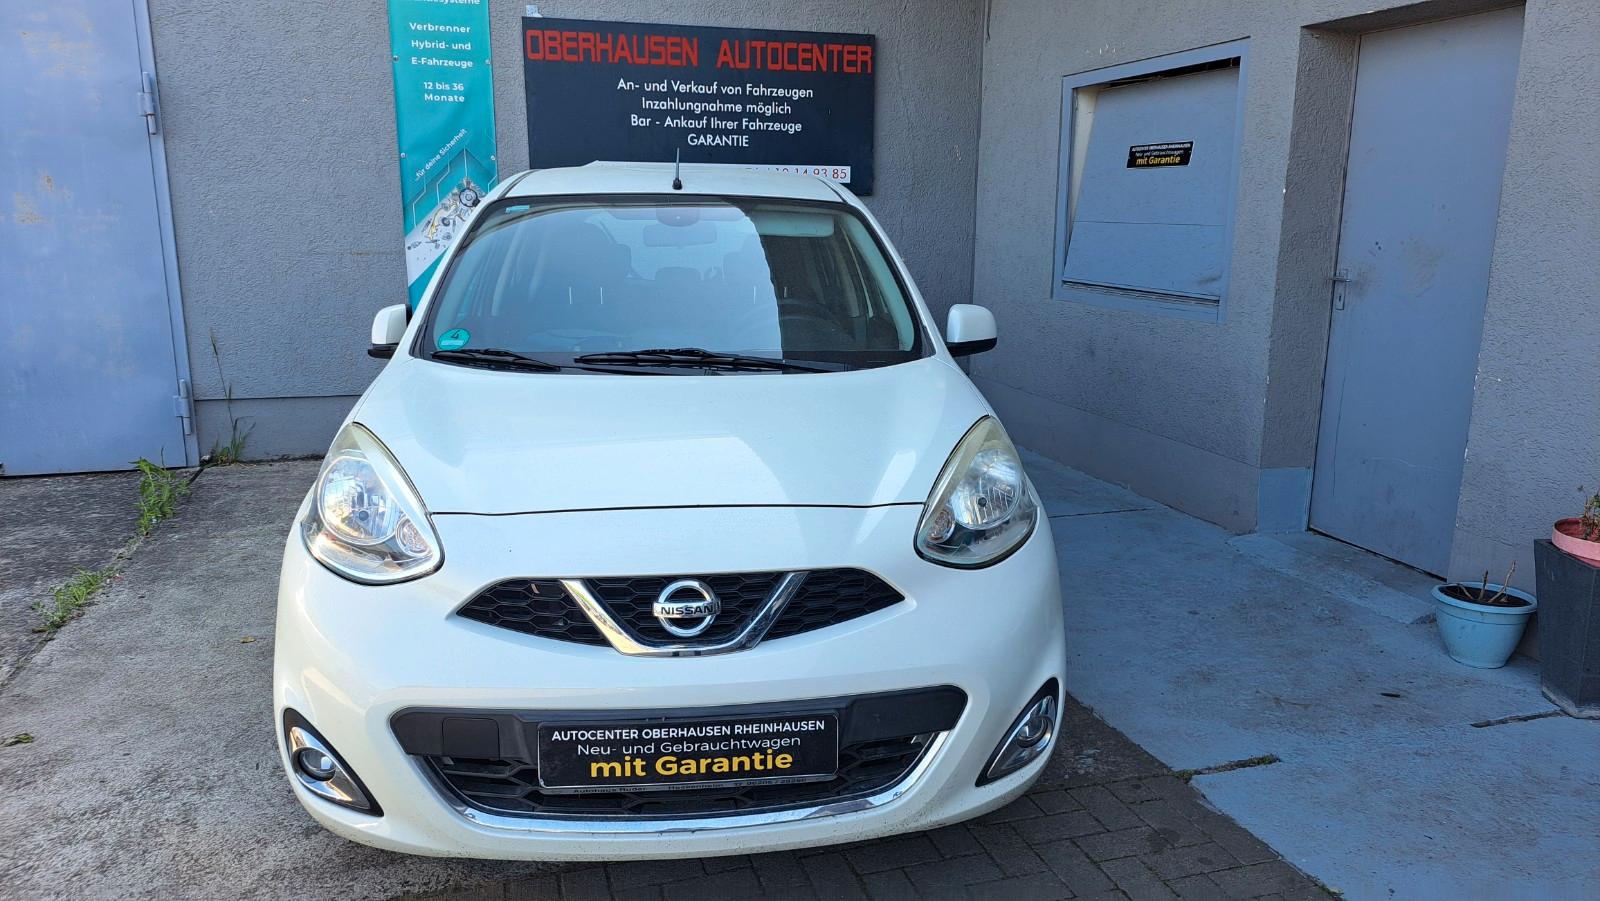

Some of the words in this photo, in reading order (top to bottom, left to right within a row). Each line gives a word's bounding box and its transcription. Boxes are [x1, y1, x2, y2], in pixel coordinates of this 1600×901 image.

[409, 22, 471, 33] Verbrenner
[411, 40, 449, 50] Hybrid-
[452, 42, 472, 51] und
[525, 29, 699, 68] OBERHAUSEN
[716, 39, 873, 74] AUTOCENTER
[411, 57, 473, 69] E-Fahrzeuge
[424, 82, 434, 90] 12
[436, 82, 450, 91] bis
[453, 83, 464, 91] 36
[617, 78, 640, 91] An-
[644, 80, 668, 92] und
[671, 80, 718, 94] Verkauf
[721, 85, 742, 95] von
[746, 83, 814, 100] Fahrzeugen
[424, 93, 465, 102] Monate
[642, 97, 743, 114] Inzahlungnahme
[746, 102, 792, 117] möglich
[631, 114, 651, 127] Bar
[664, 115, 707, 129] Ankauf
[711, 117, 738, 130] Ihrer
[742, 118, 802, 134] Fahrzeuge
[687, 133, 749, 147] GARANTIE
[425, 154, 441, 171] deine
[439, 128, 468, 156] Sicherheit
[1136, 157, 1148, 165] mit
[1148, 155, 1180, 165] Garantie
[832, 168, 847, 179] 85
[660, 605, 714, 615] NISSAN
[551, 729, 639, 741] AUTOCENTER
[642, 725, 731, 739] OBERHAUSEN
[734, 720, 825, 735] RHEINHAUSEN
[577, 744, 617, 756] Neu-
[622, 742, 655, 755] und
[660, 737, 801, 753] Gebrauchtwagen
[590, 755, 647, 778] mit
[655, 748, 793, 776] Garantie
